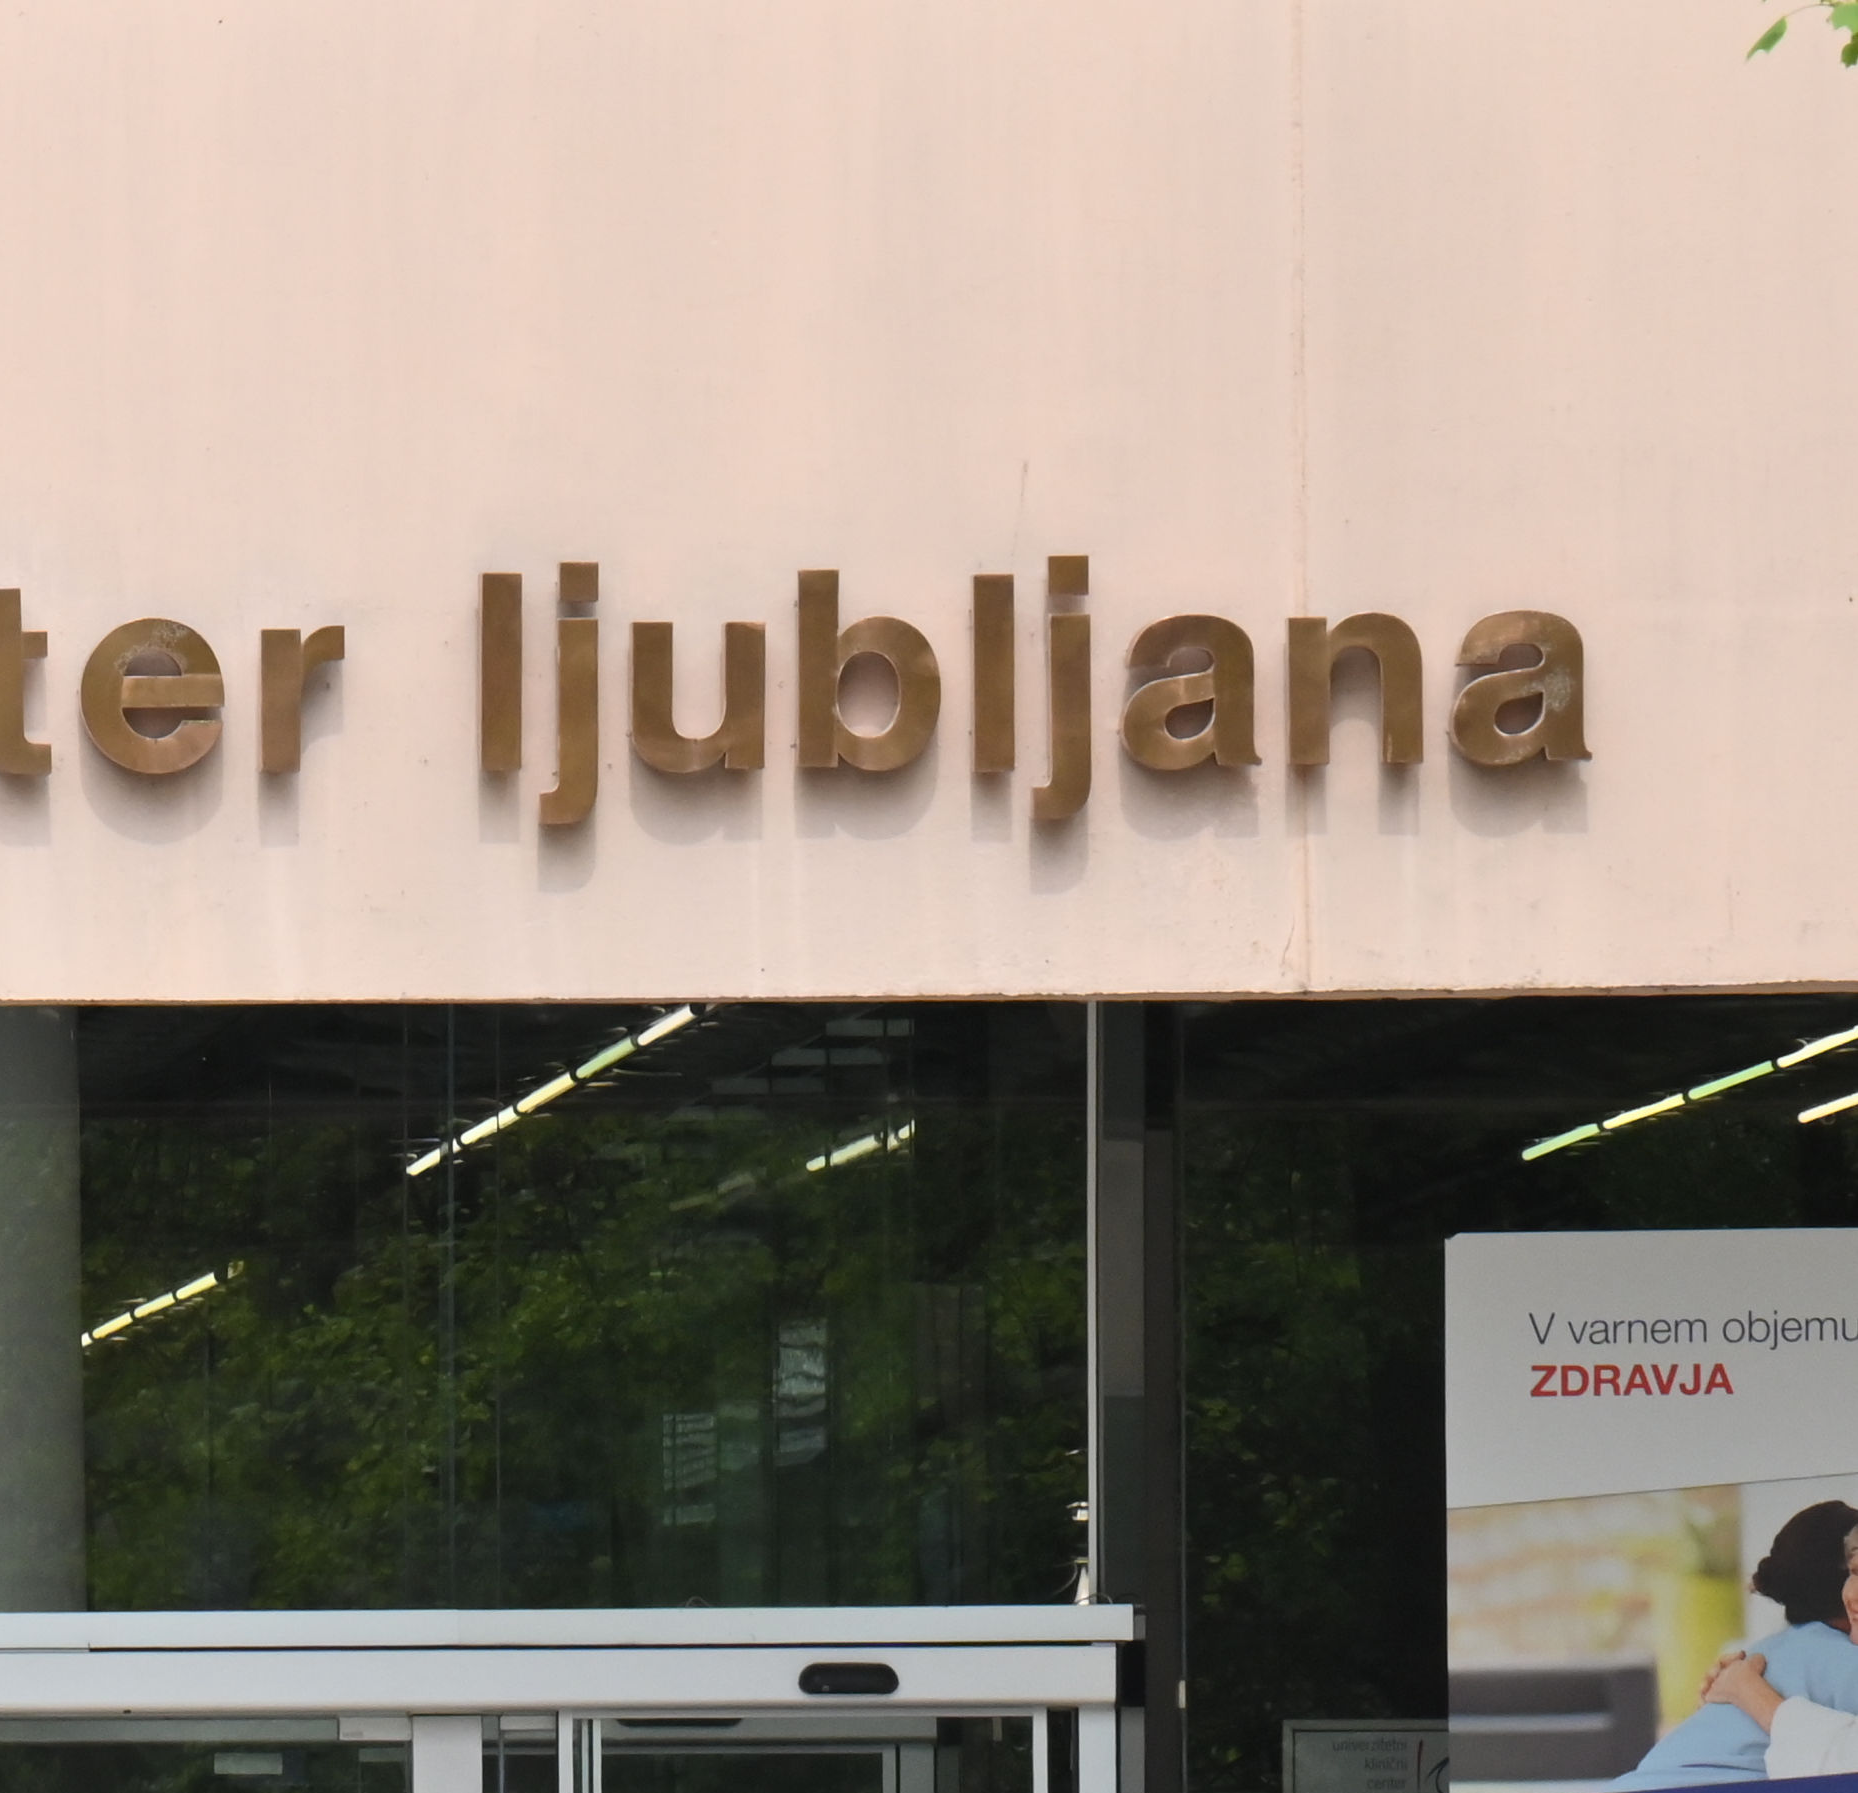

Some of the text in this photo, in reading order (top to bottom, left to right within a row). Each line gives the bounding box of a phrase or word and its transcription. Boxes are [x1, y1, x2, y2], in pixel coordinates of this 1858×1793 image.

[478, 555, 1593, 825] ljubljana
[1529, 1312, 1555, 1344] V
[1568, 1319, 1707, 1344] varnem
[1530, 1363, 1734, 1396] ZDRAVJA
